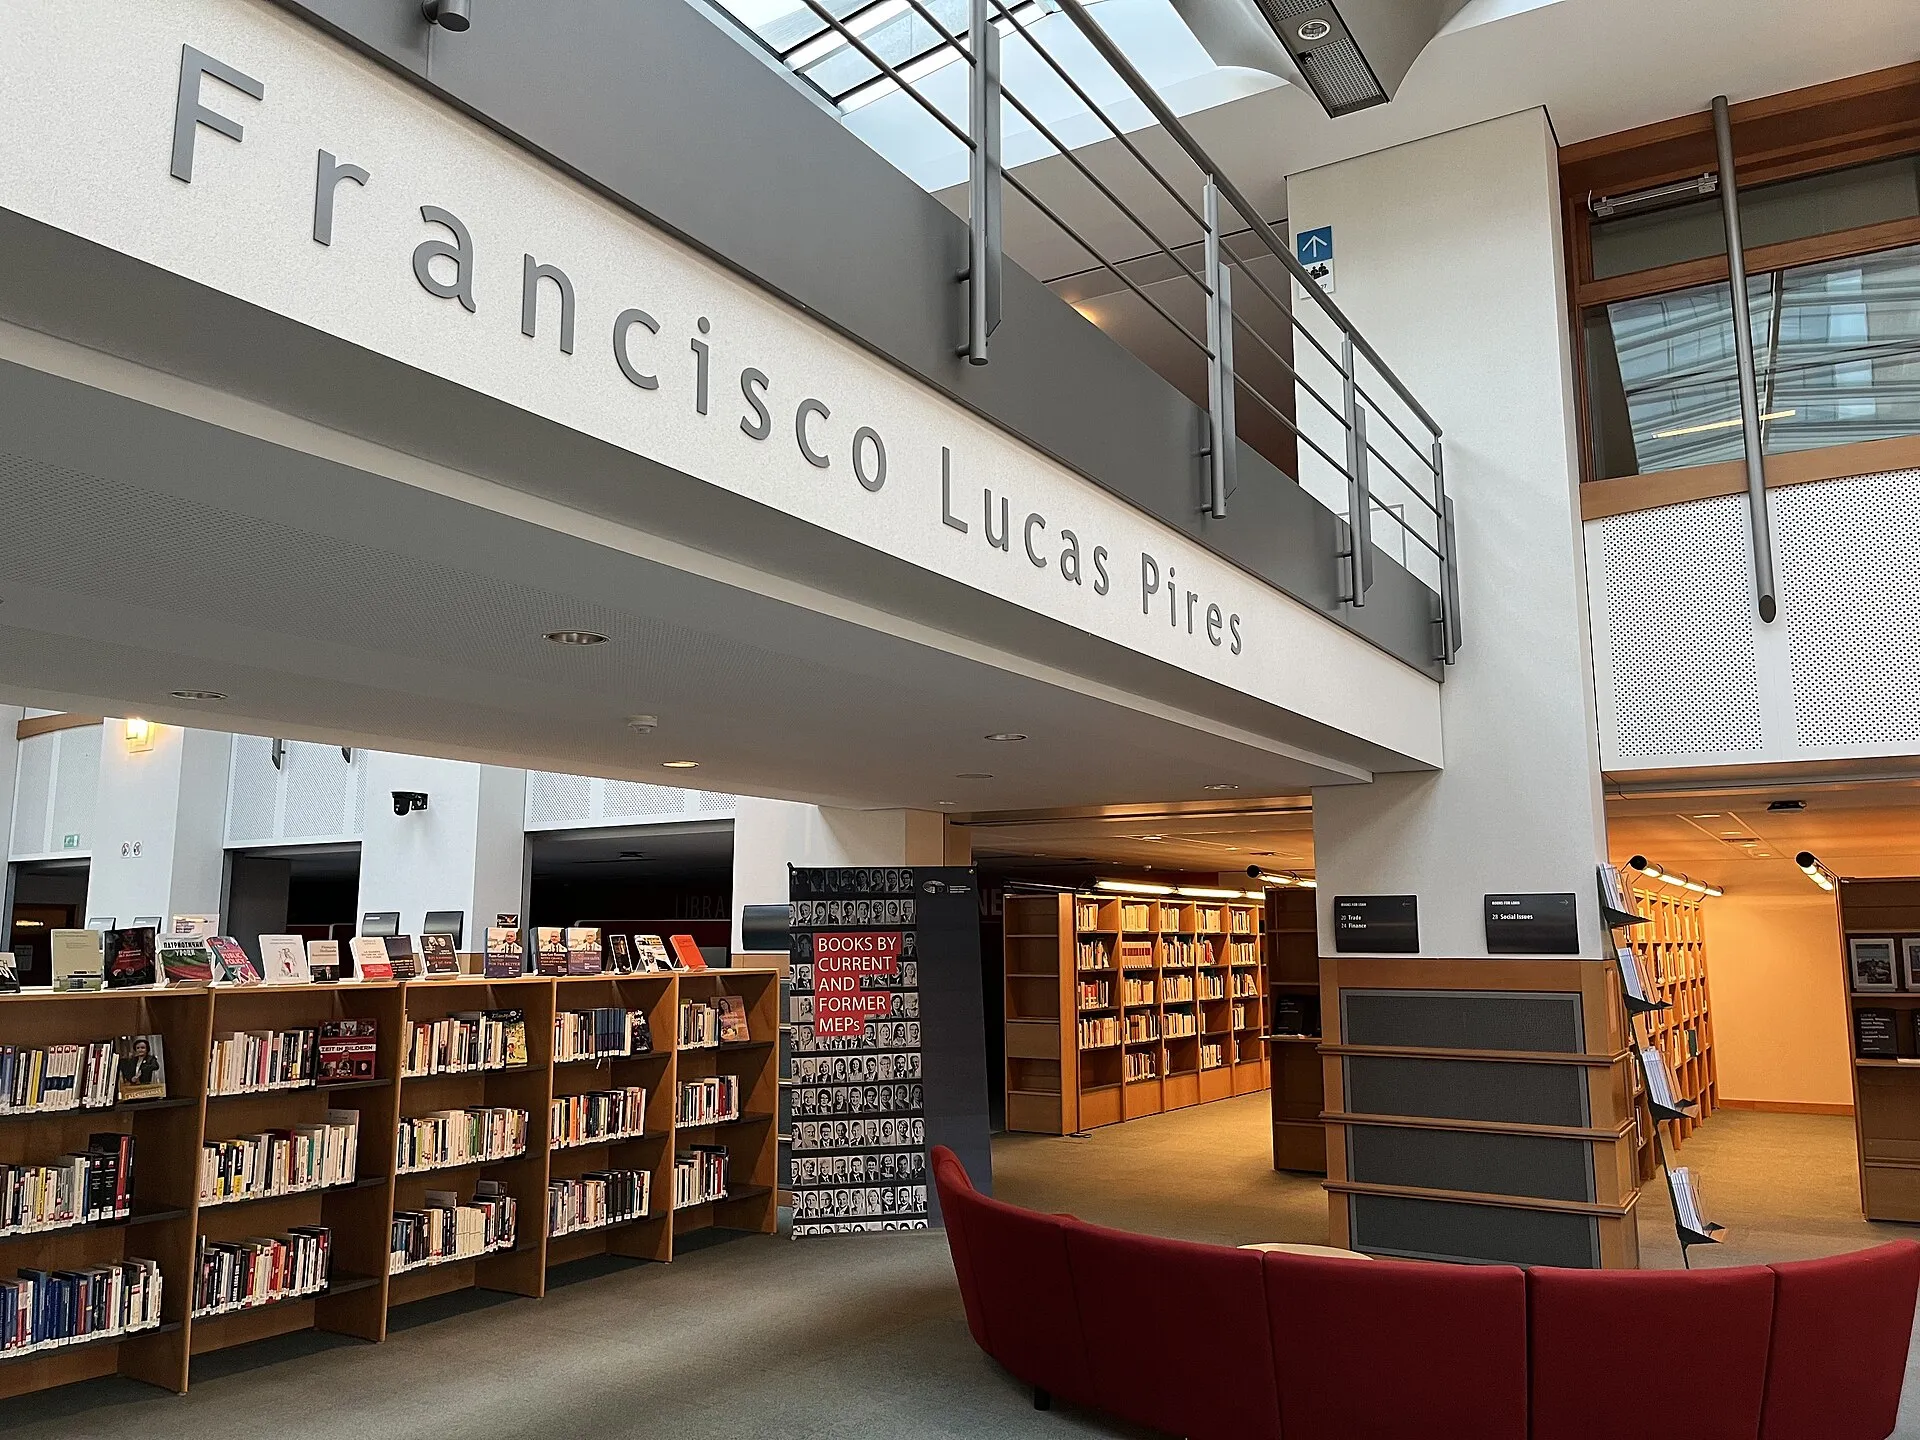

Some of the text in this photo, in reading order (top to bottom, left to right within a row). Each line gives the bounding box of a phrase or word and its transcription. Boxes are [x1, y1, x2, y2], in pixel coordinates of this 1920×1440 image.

[170, 43, 1242, 656] Francisco Lucas Pires
[818, 936, 898, 952] BOOKS BY
[818, 956, 893, 972] CURRENT
[818, 977, 855, 992] AND
[819, 996, 887, 1012] FORMER
[819, 1016, 861, 1033] MEPs
